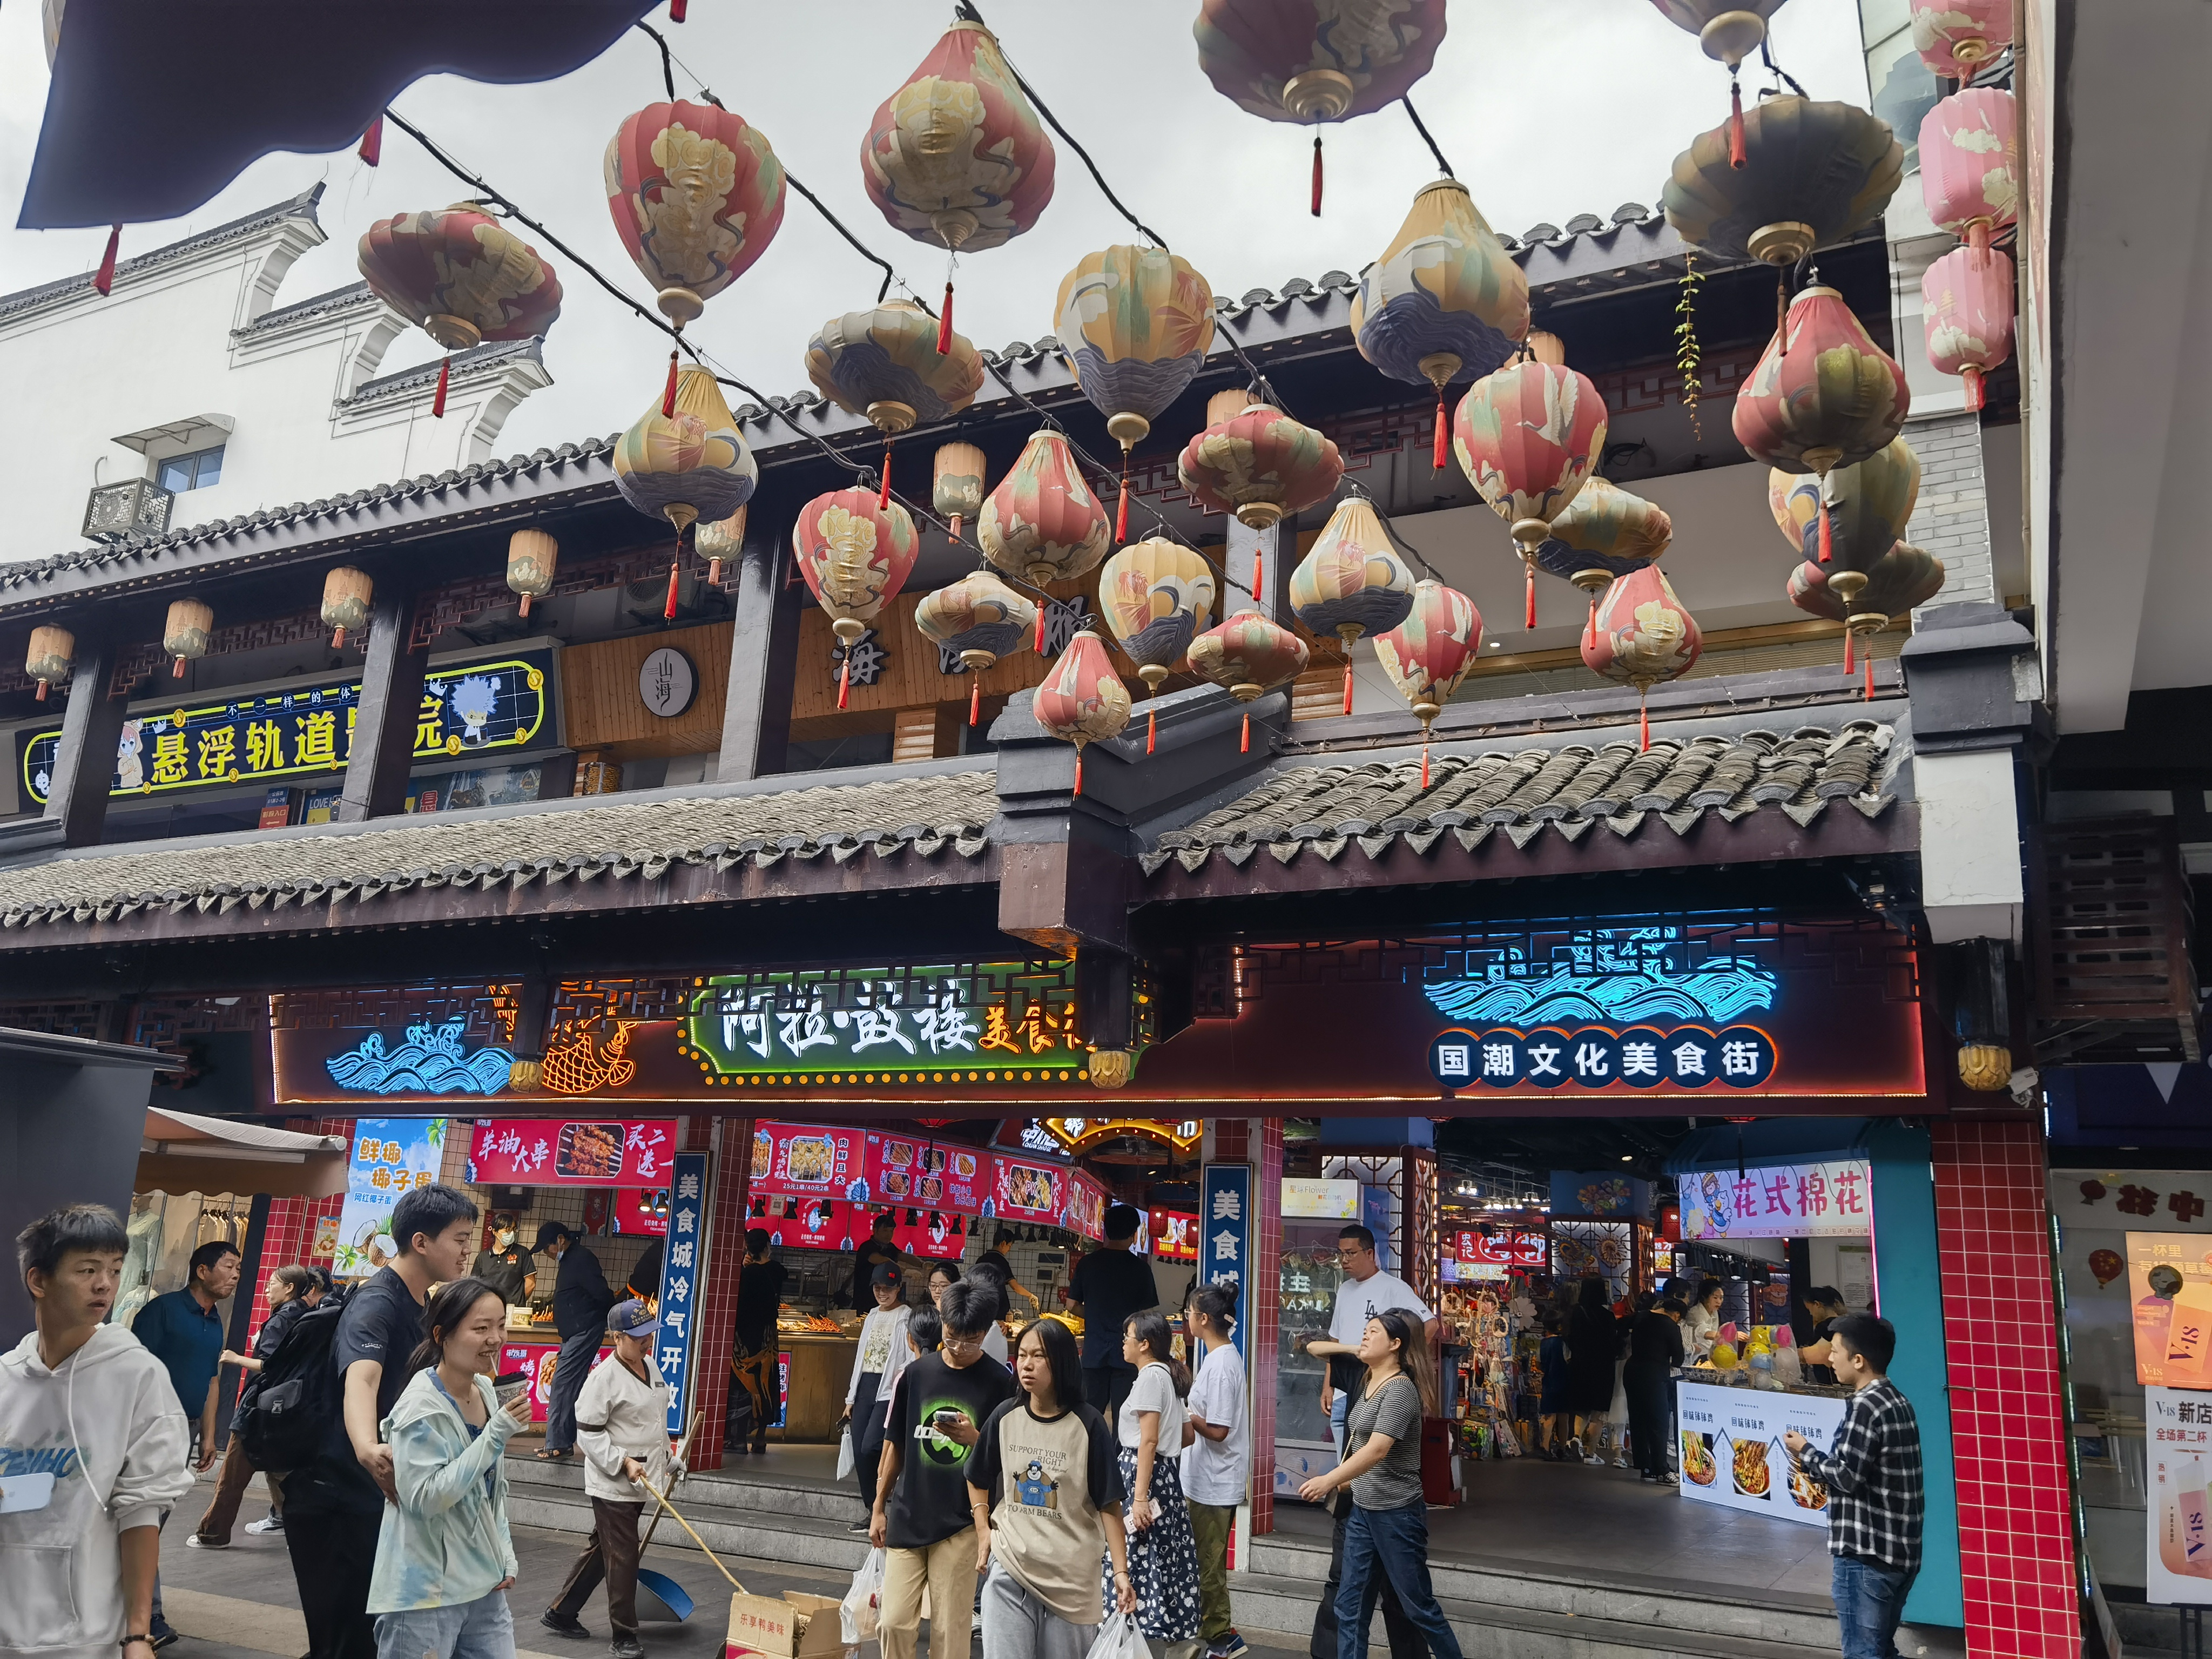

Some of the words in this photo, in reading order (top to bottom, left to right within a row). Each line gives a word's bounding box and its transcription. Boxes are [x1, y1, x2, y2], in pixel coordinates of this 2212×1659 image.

[655, 652, 672, 712] 山海
[152, 695, 443, 783] 悬浮轨道院
[1438, 1041, 1760, 1077] 国潮文化美食街
[359, 1138, 402, 1164] 鲜椰
[835, 1138, 848, 1185] 肉鲜且大
[783, 1183, 829, 1191] 25元1串/40元2串
[1026, 1181, 1037, 1196] PK
[1733, 1170, 1864, 1218] 花式棉花
[2139, 1244, 2182, 1258] 一杯里
[1365, 1300, 1378, 1319] LA
[1683, 1410, 1713, 1424] 回味钵钵鸡
[1731, 1417, 1764, 1431] 回味钵钵鸡
[2156, 1428, 2207, 1443] 全场第二杯
[1009, 1444, 1043, 1456] SUPPORT
[1044, 1449, 1067, 1460] YOUR
[1038, 1456, 1063, 1466] RIGHT
[1007, 1504, 1018, 1512] TO
[1019, 1506, 1035, 1515] ARM
[1037, 1509, 1062, 1520] BEARS
